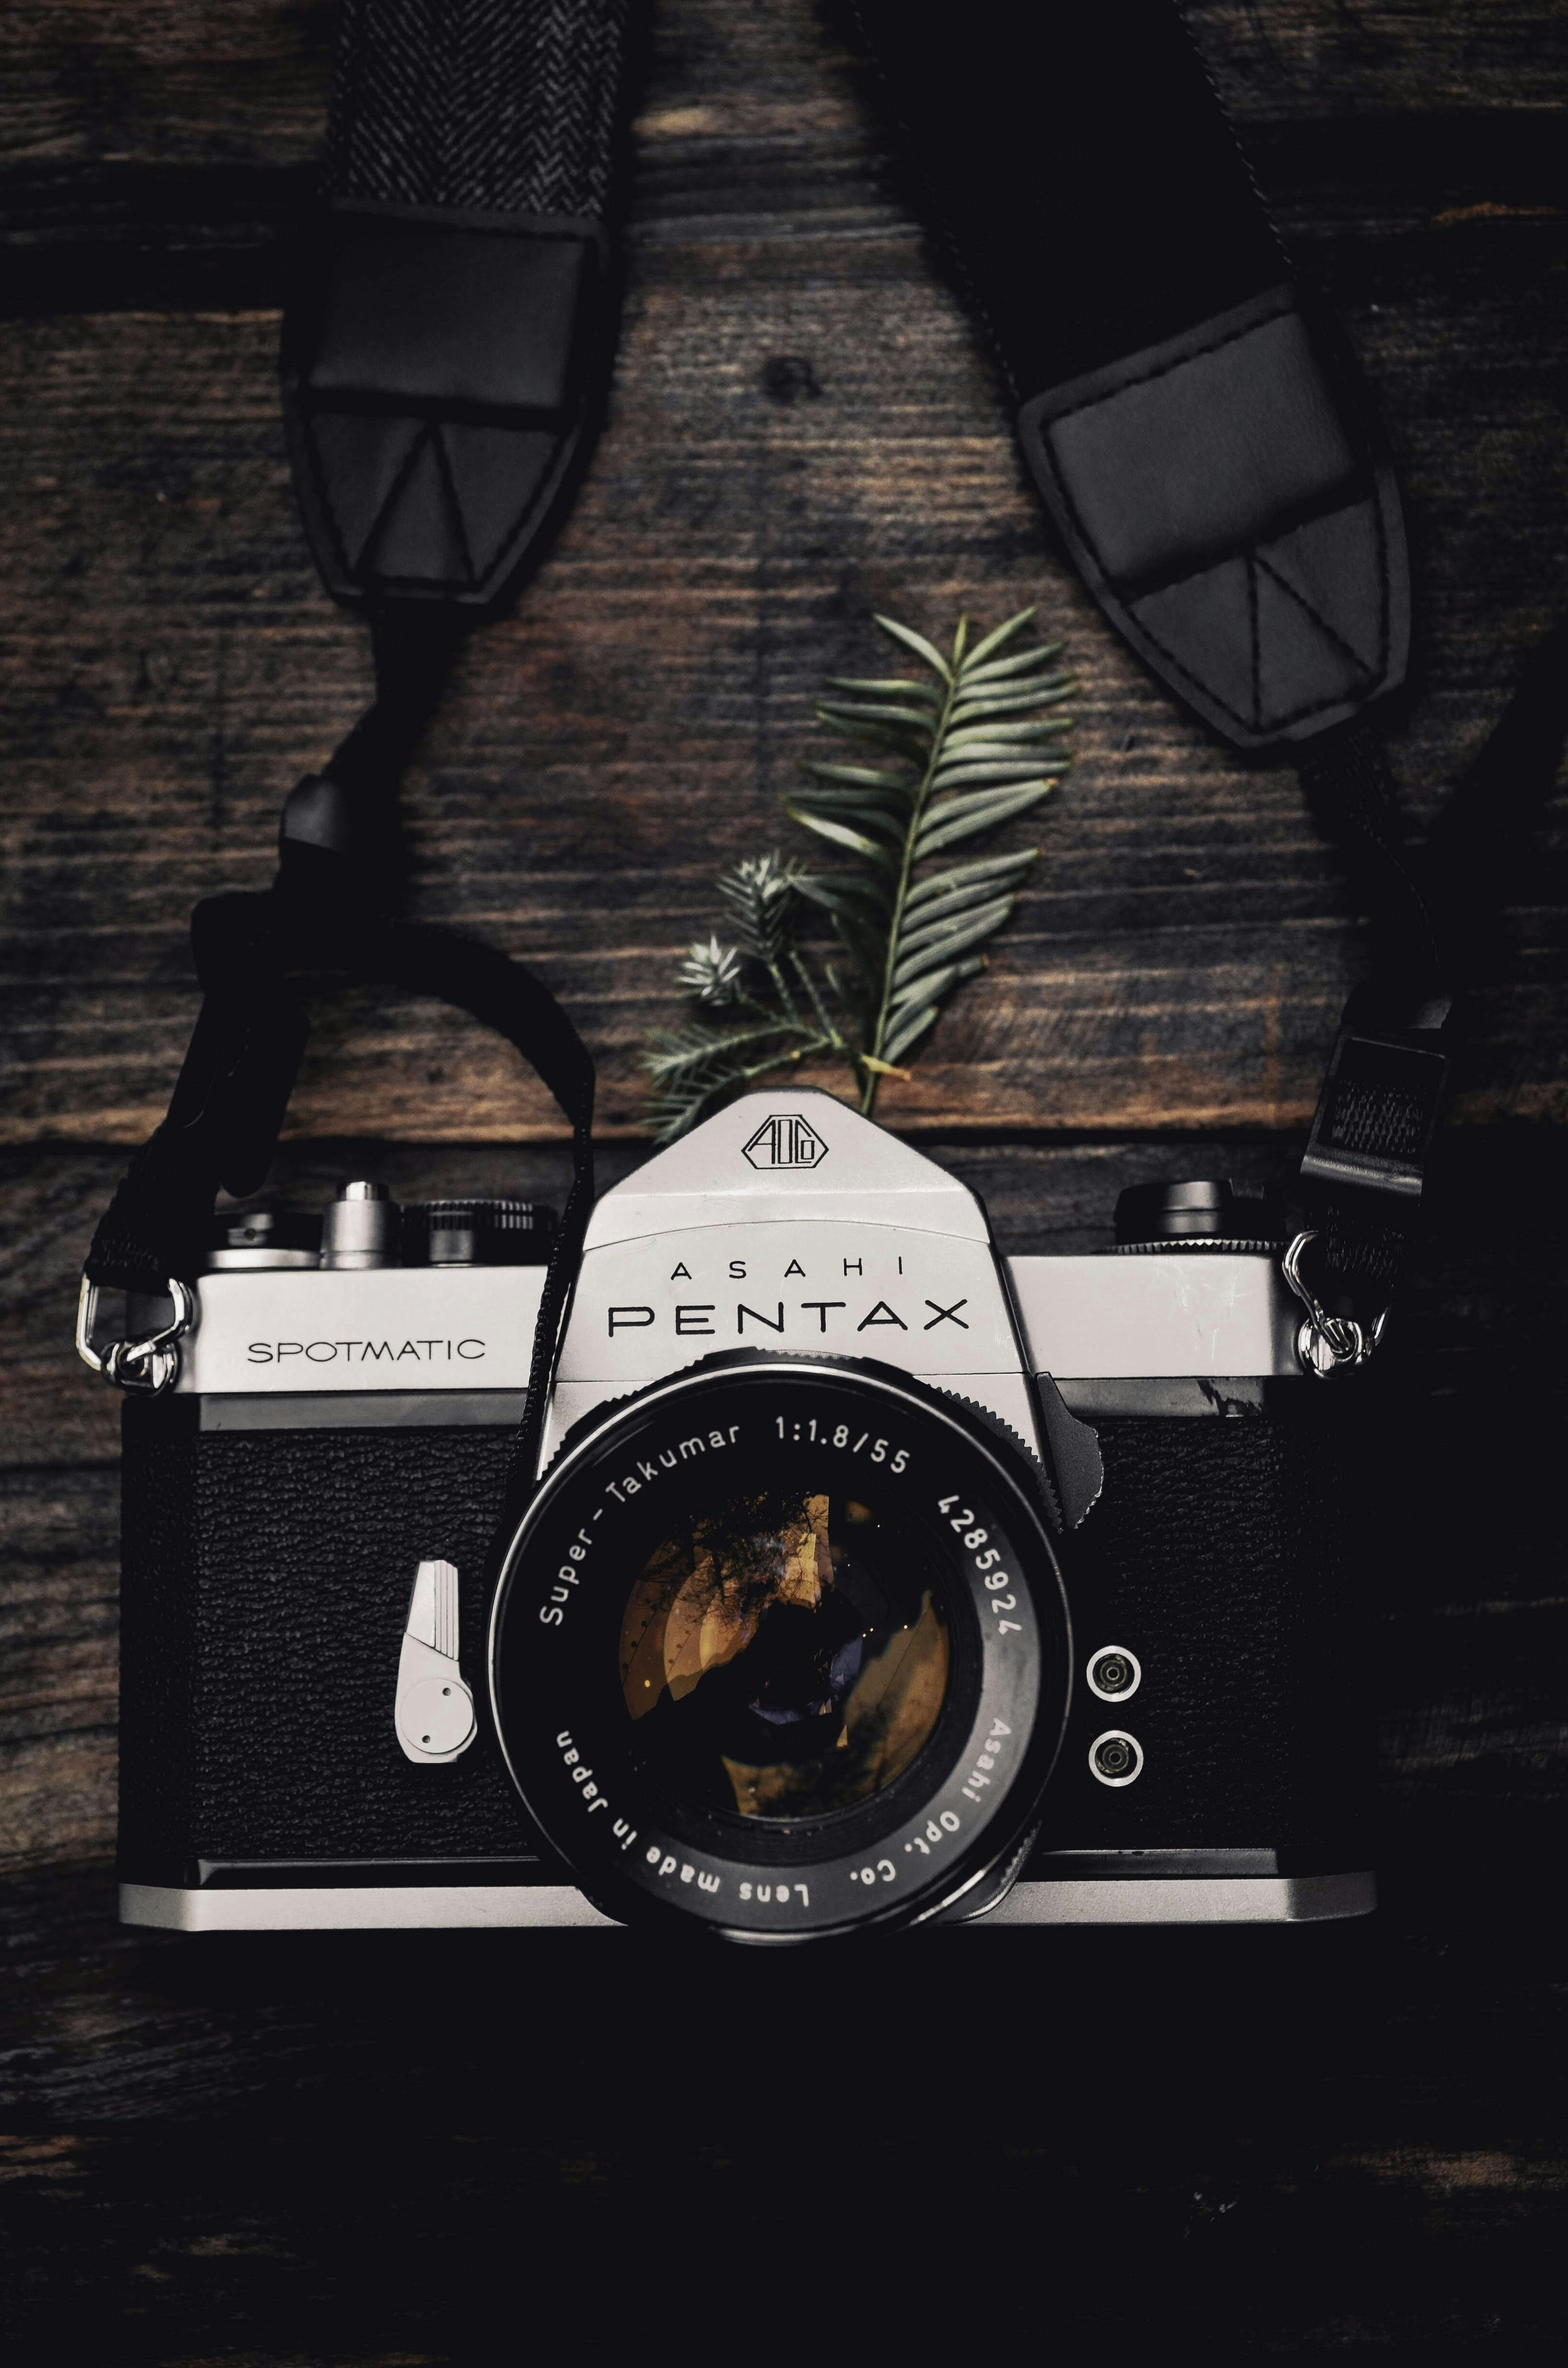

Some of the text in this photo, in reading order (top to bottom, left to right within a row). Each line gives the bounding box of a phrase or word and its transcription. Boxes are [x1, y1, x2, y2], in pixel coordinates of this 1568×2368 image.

[670, 1256, 903, 1280] ASAHI
[608, 1298, 969, 1337] PENTAX
[247, 1339, 486, 1363] SPOTMATIC
[775, 1416, 911, 1474] 1:1.8/55
[937, 1494, 1023, 1635] 4285924
[556, 1717, 1012, 1907] Asahi Opt. Co. Lens made in Japan
